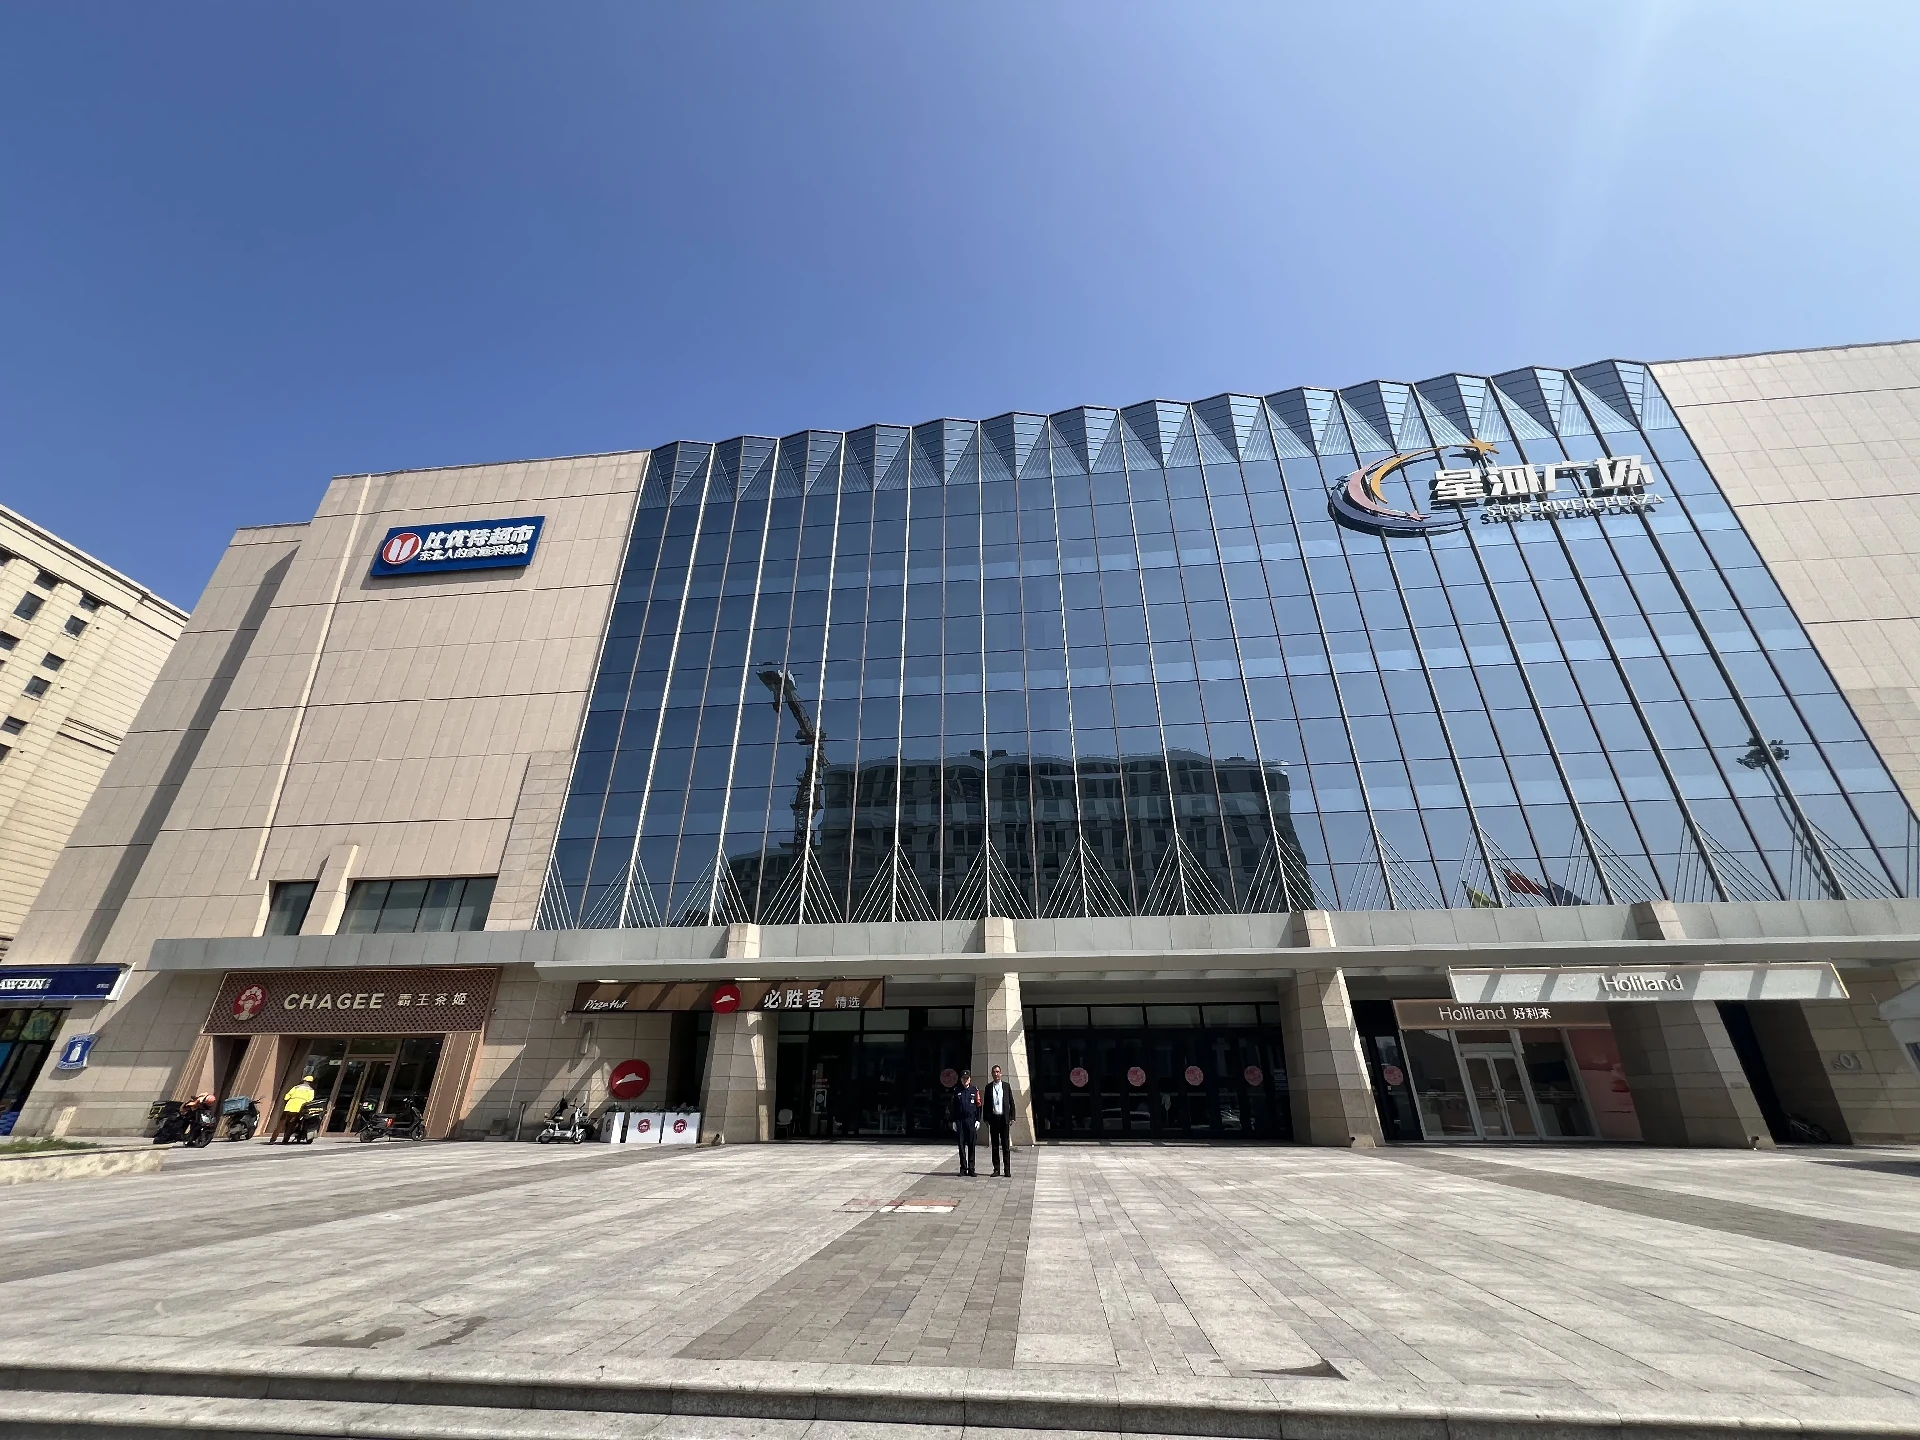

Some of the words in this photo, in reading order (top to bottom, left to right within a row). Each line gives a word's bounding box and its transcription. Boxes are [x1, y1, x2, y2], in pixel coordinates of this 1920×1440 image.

[1431, 455, 1655, 500] 星河广场
[1486, 502, 1532, 517] STAR
[1539, 497, 1598, 513] RIVER
[1602, 493, 1666, 507] PLAZA
[423, 525, 536, 550] 比优特超市
[1602, 975, 1685, 992] Holiland
[283, 993, 385, 1010] CHAGEE
[397, 992, 468, 1007] 霸王茶姬
[583, 999, 609, 1010] Pizza
[609, 999, 629, 1009] Hut
[763, 988, 825, 1009] 必胜客
[835, 995, 861, 1009] 精选
[1439, 1006, 1507, 1021] Holiland
[1512, 1006, 1552, 1020] 好利来
